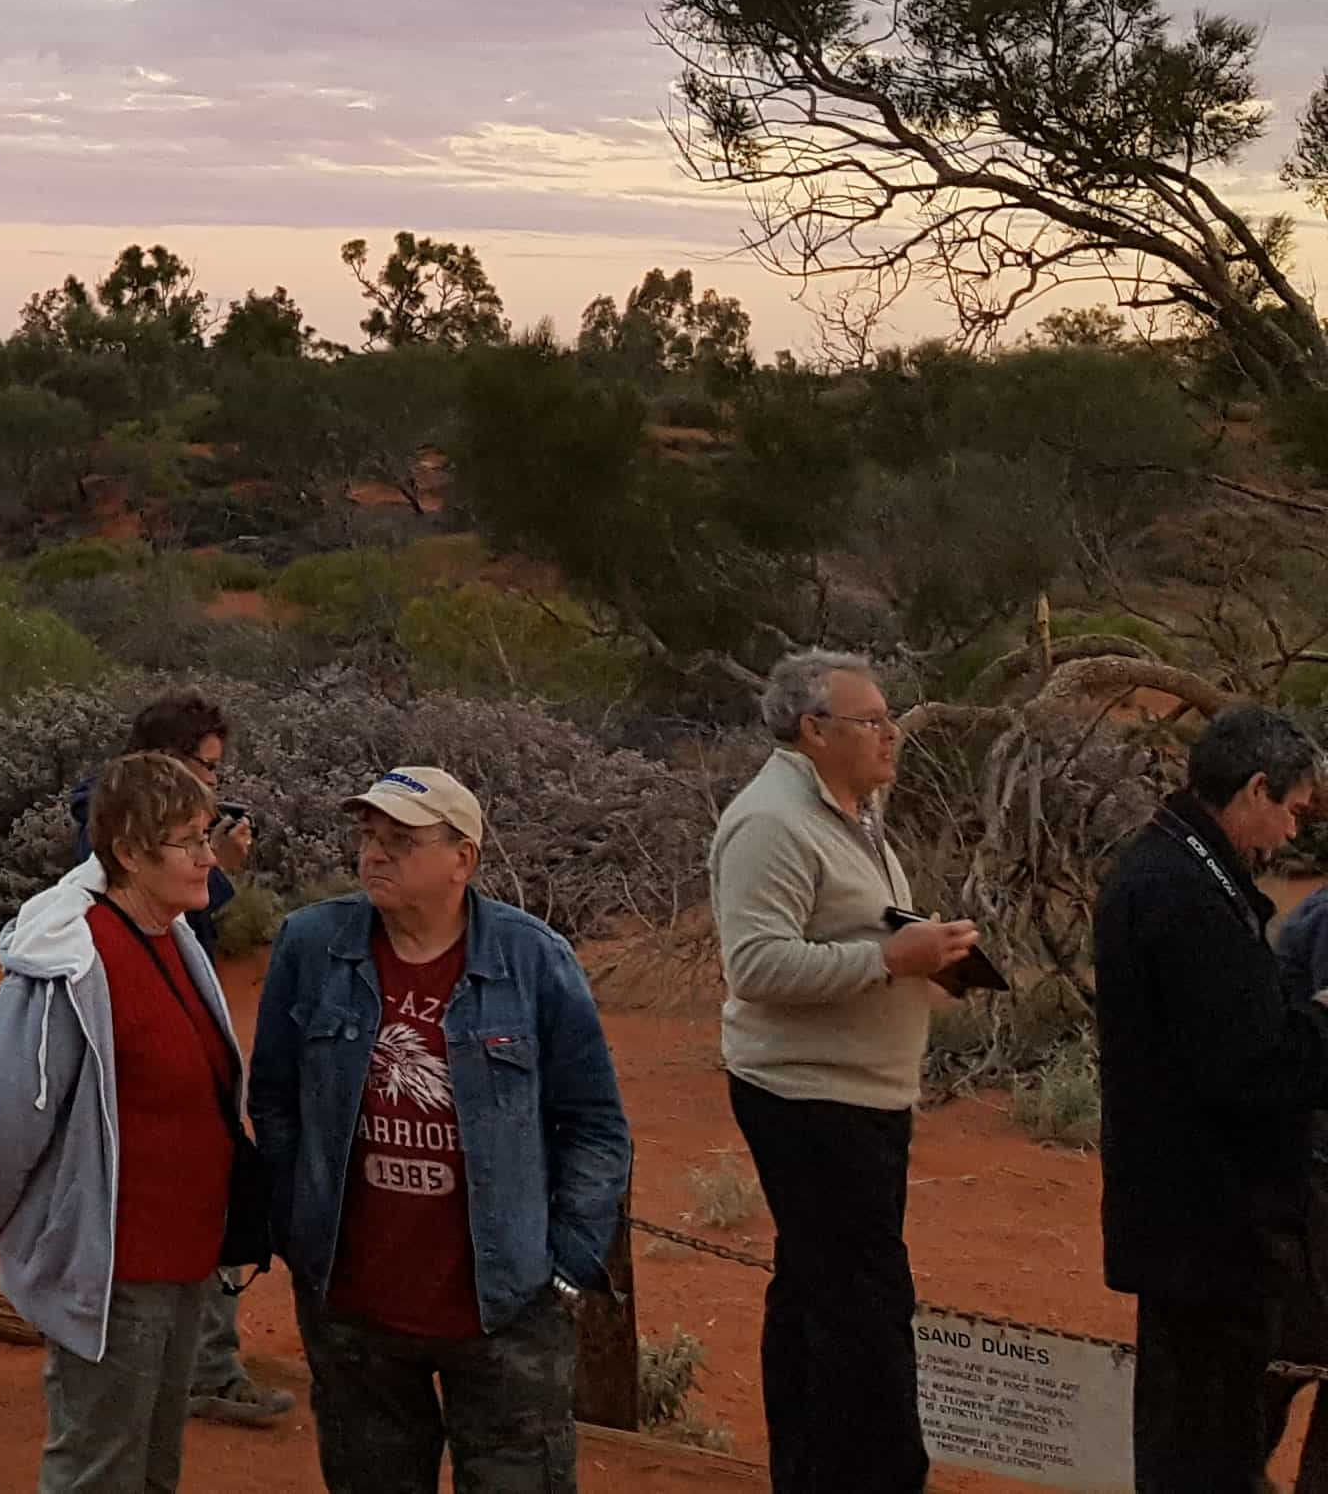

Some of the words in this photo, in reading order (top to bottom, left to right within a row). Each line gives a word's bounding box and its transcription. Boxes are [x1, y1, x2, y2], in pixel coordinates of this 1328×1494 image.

[1186, 835, 1208, 857] EOS
[377, 1160, 442, 1191] 1985
[917, 1326, 971, 1349] SAND
[982, 1338, 1050, 1365] DUNES
